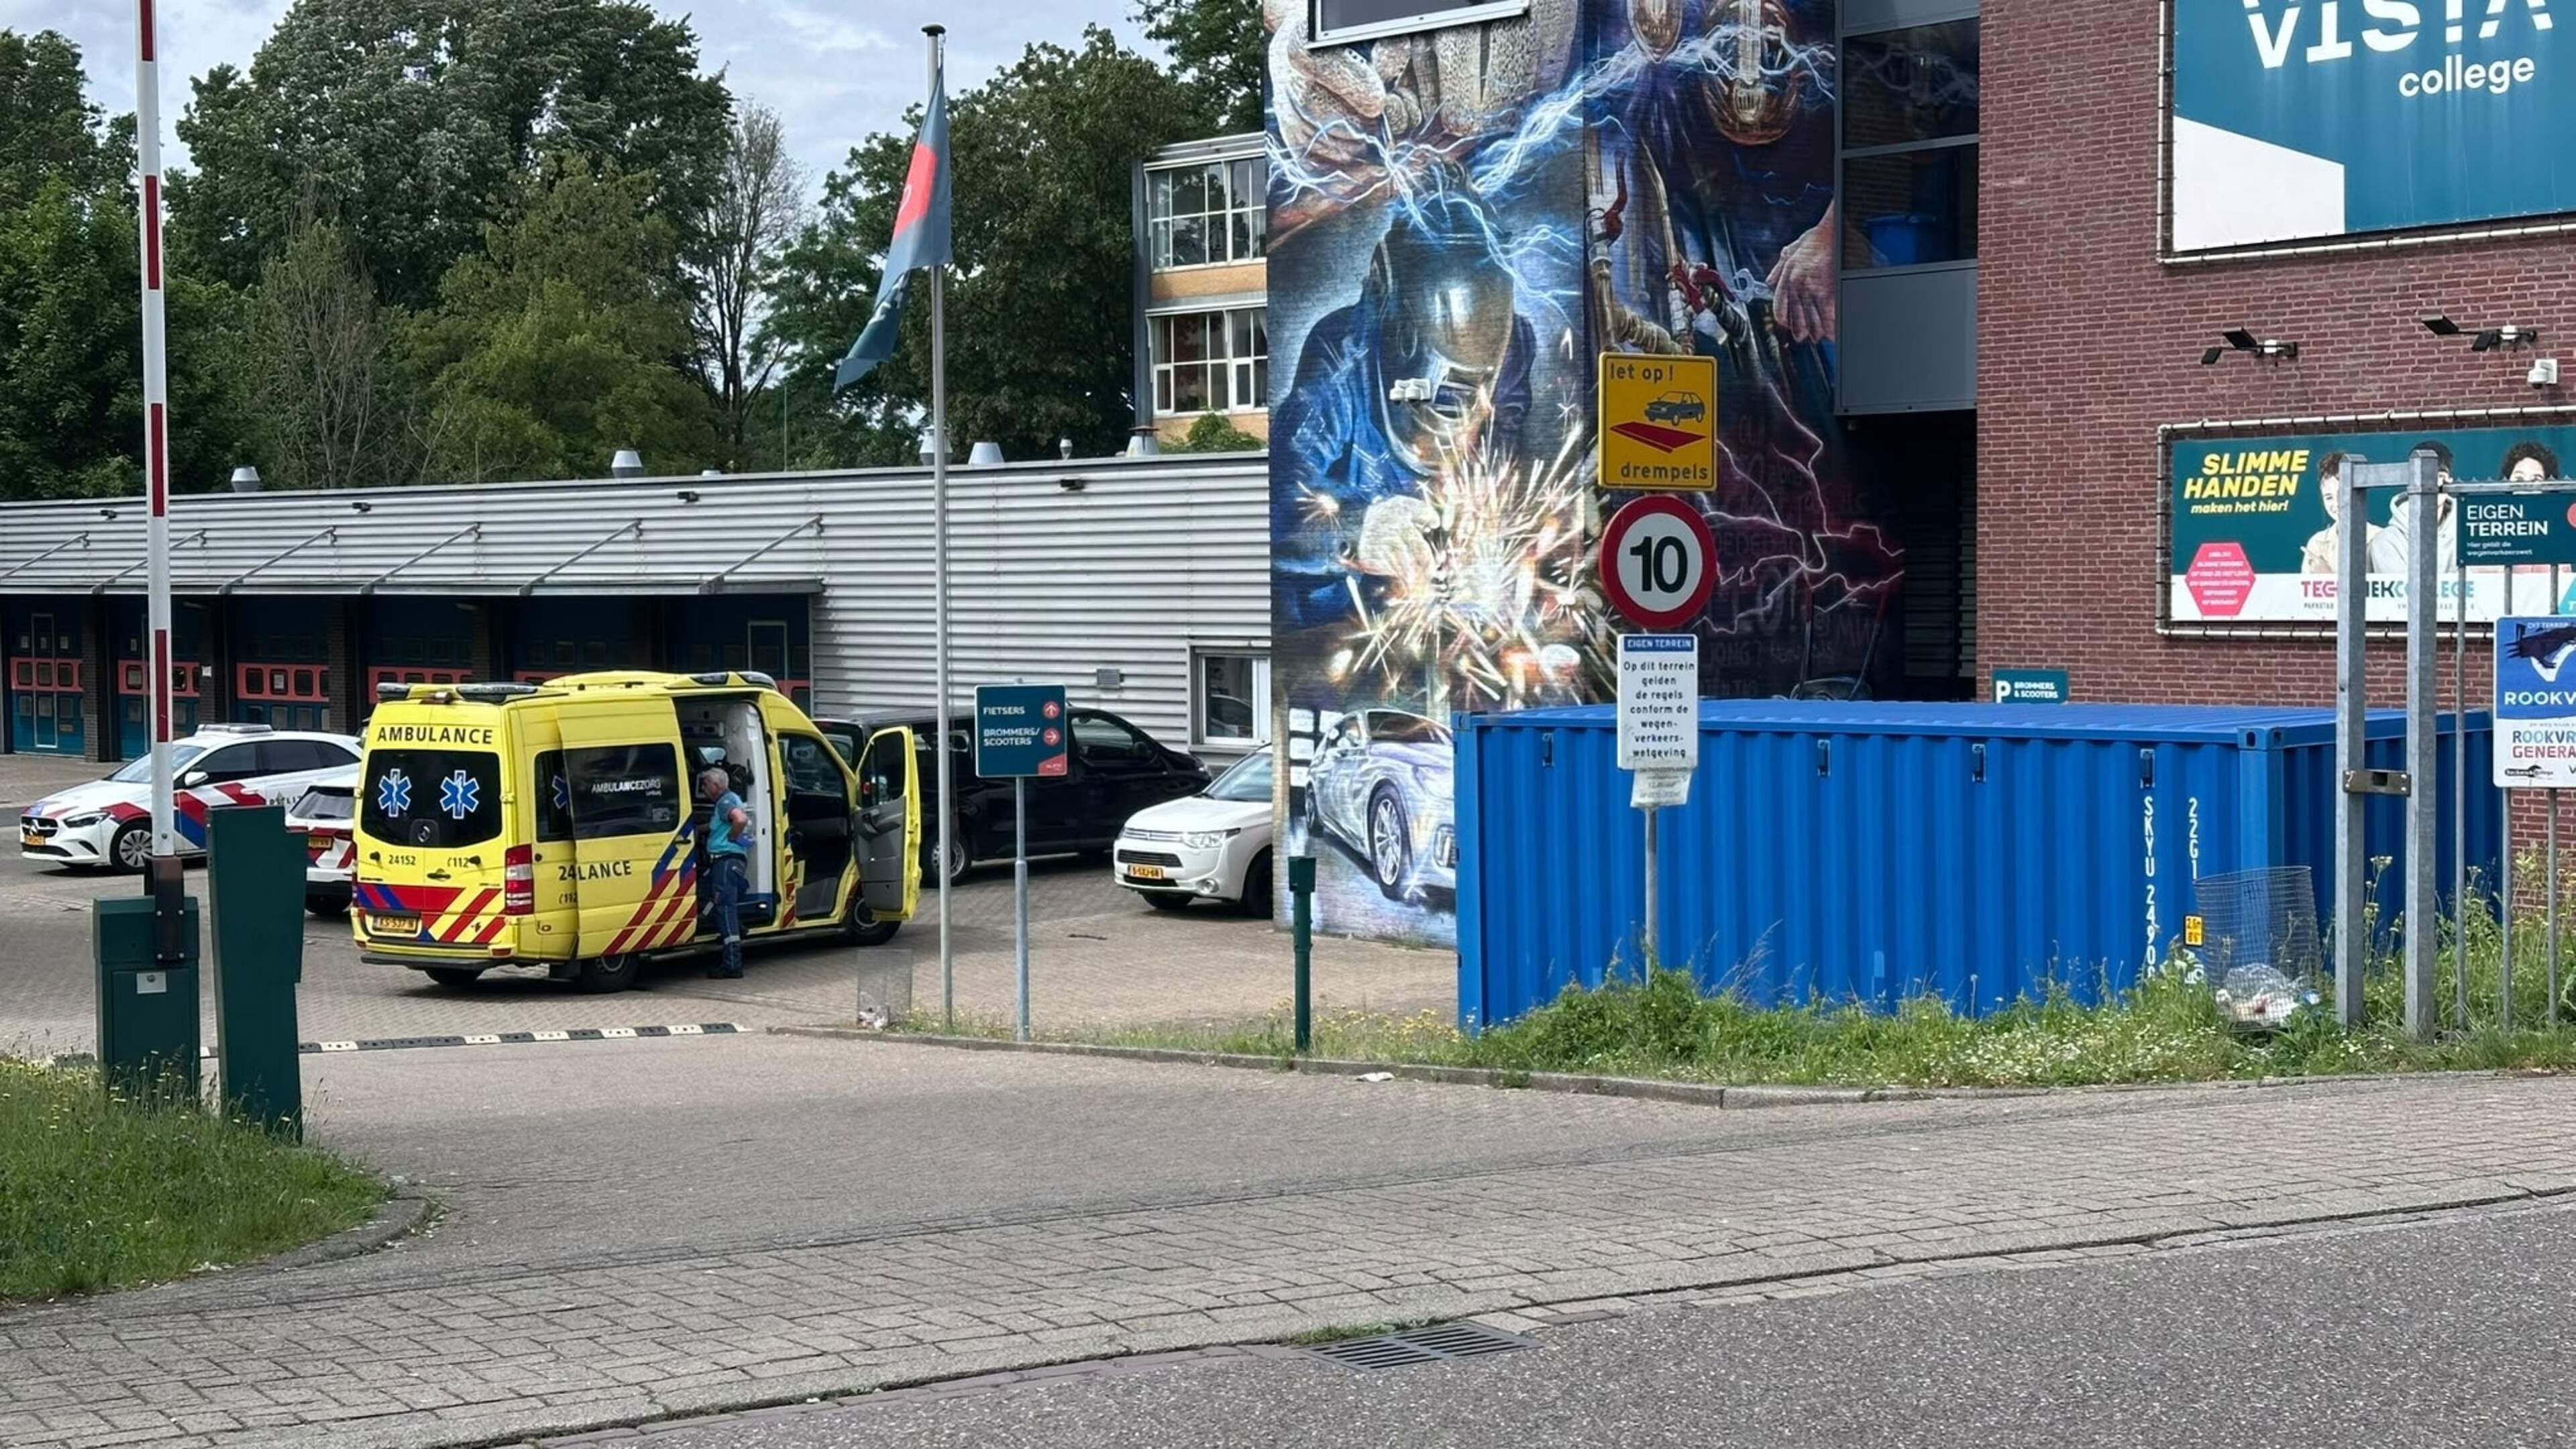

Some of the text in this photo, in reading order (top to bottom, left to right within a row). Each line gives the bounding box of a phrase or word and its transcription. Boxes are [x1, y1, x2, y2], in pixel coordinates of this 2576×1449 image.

[2399, 54, 2534, 97] college
[1610, 363, 1634, 380] let
[2202, 450, 2310, 475] SLIMME
[1621, 463, 1708, 482] drempels
[2184, 474, 2299, 499] HANDEN
[2190, 500, 2289, 514] maken het hier!
[2467, 504, 2523, 520] EIGEN
[2466, 521, 2548, 537] TERREIN
[1630, 536, 1688, 594] 10
[1627, 639, 1691, 648] EIGEN TERREIN
[1623, 661, 1695, 672] Op dit terrein
[1642, 676, 1676, 687] gelden
[1635, 691, 1682, 701] de regels
[1996, 680, 2011, 703] P
[983, 706, 1025, 716] FIETSERS
[1630, 705, 1688, 714] conform de
[1641, 720, 1678, 730] wegen-
[377, 727, 492, 744] AMBULANCE
[983, 737, 1032, 747] SCOOTERS
[1633, 749, 1686, 759] wetgeving
[2144, 796, 2155, 877] SKYU
[388, 855, 416, 865] 24152
